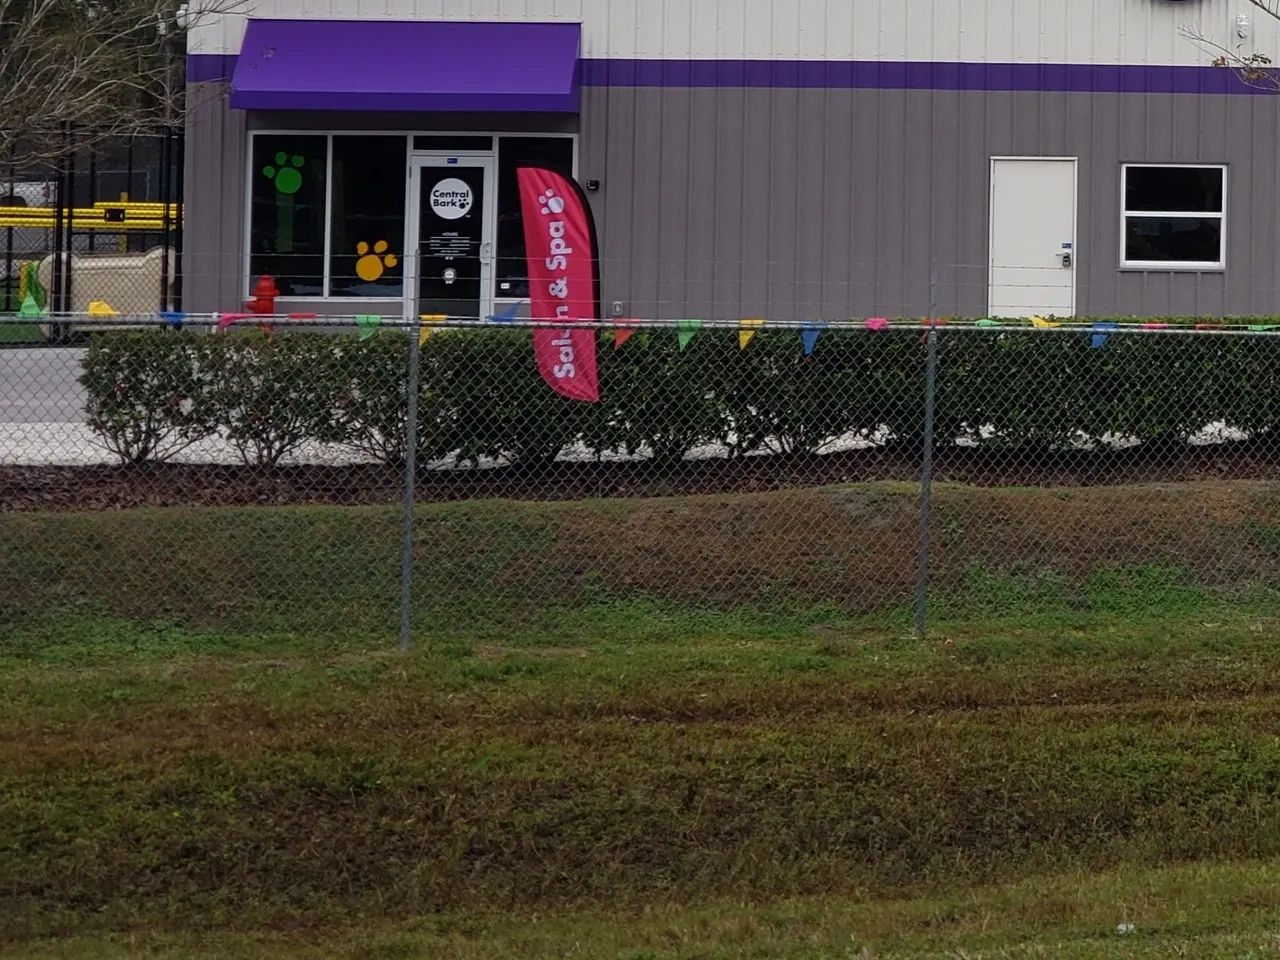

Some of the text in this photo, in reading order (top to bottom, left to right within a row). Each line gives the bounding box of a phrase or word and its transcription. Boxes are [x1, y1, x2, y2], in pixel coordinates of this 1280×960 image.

[433, 190, 469, 198] Central
[433, 199, 457, 207] Bark
[545, 221, 575, 378] Saln & Spa
